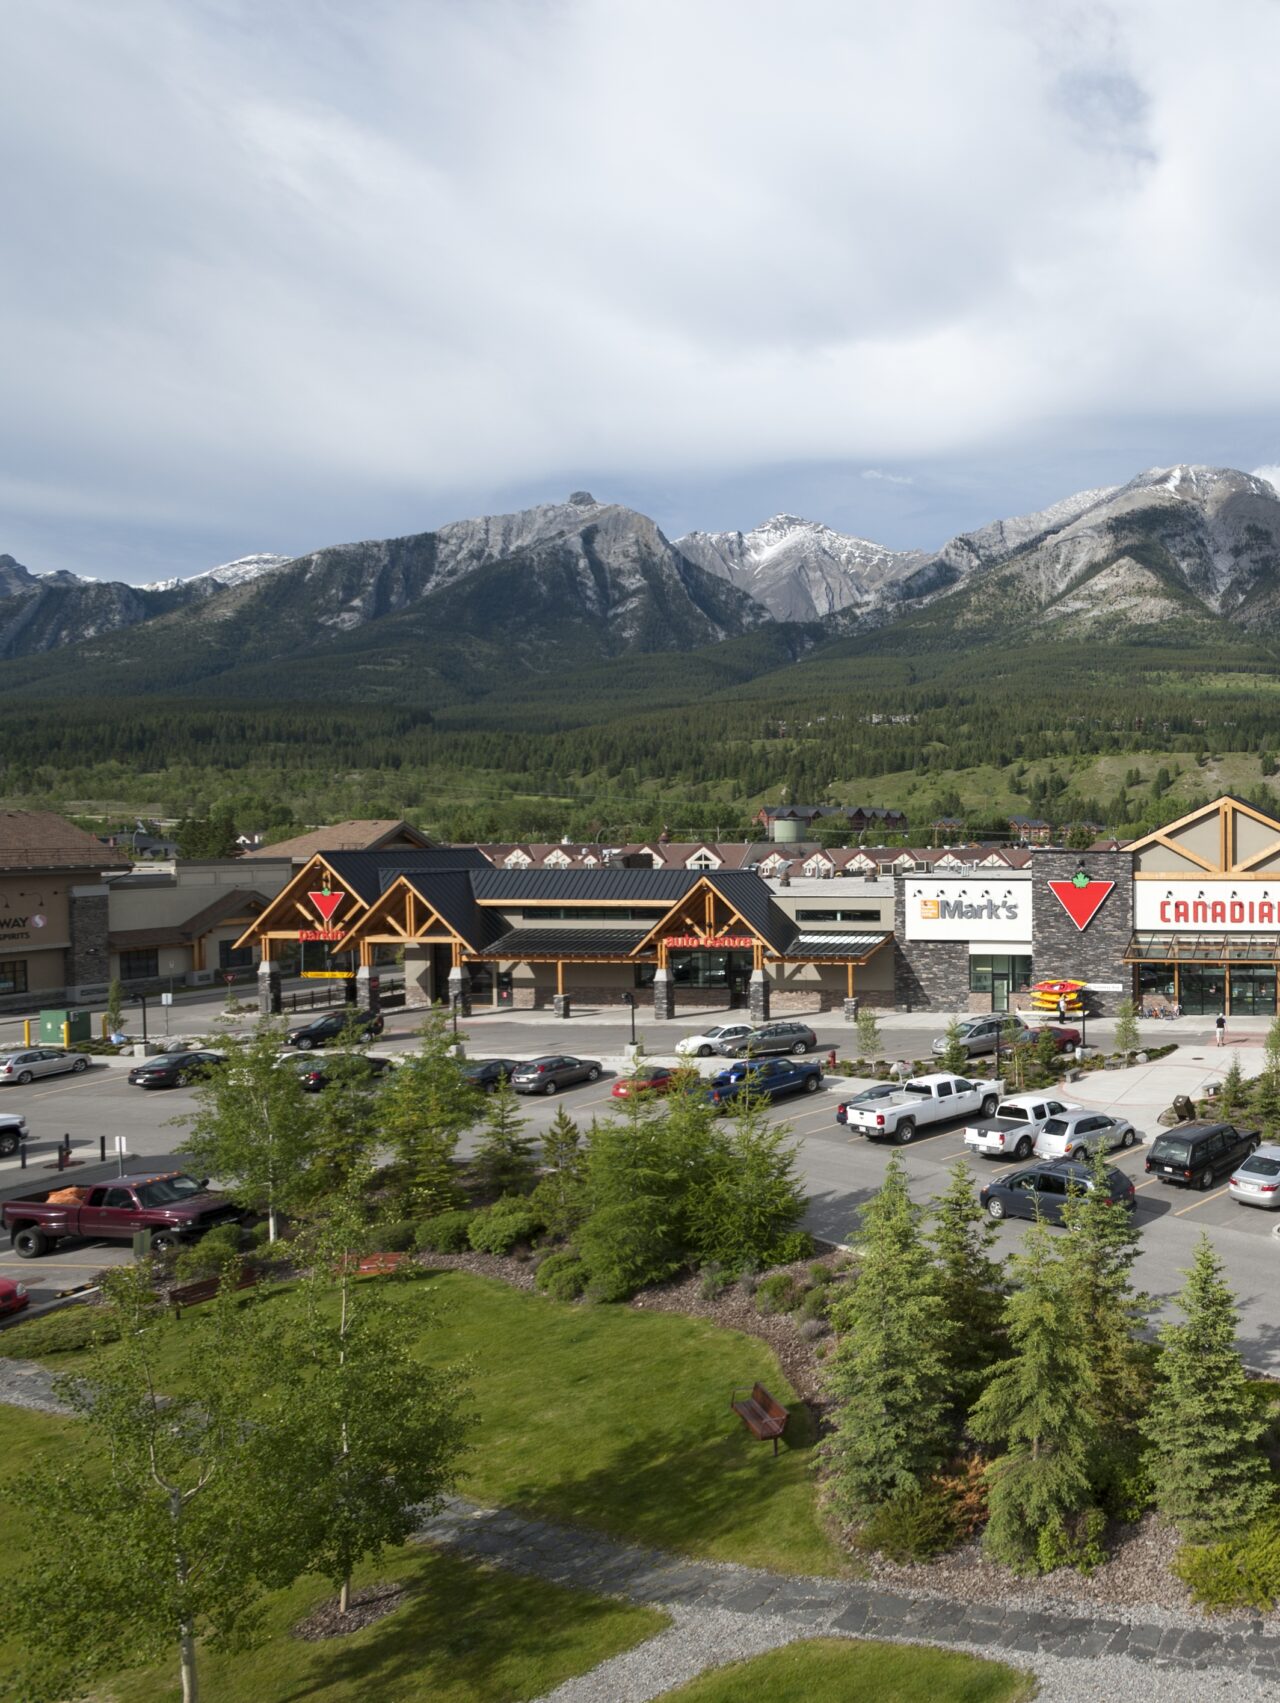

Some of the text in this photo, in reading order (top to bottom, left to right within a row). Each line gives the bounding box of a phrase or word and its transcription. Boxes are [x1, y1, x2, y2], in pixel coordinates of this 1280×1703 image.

[940, 899, 1018, 920] Mark's
[665, 933, 753, 948] auto centre
